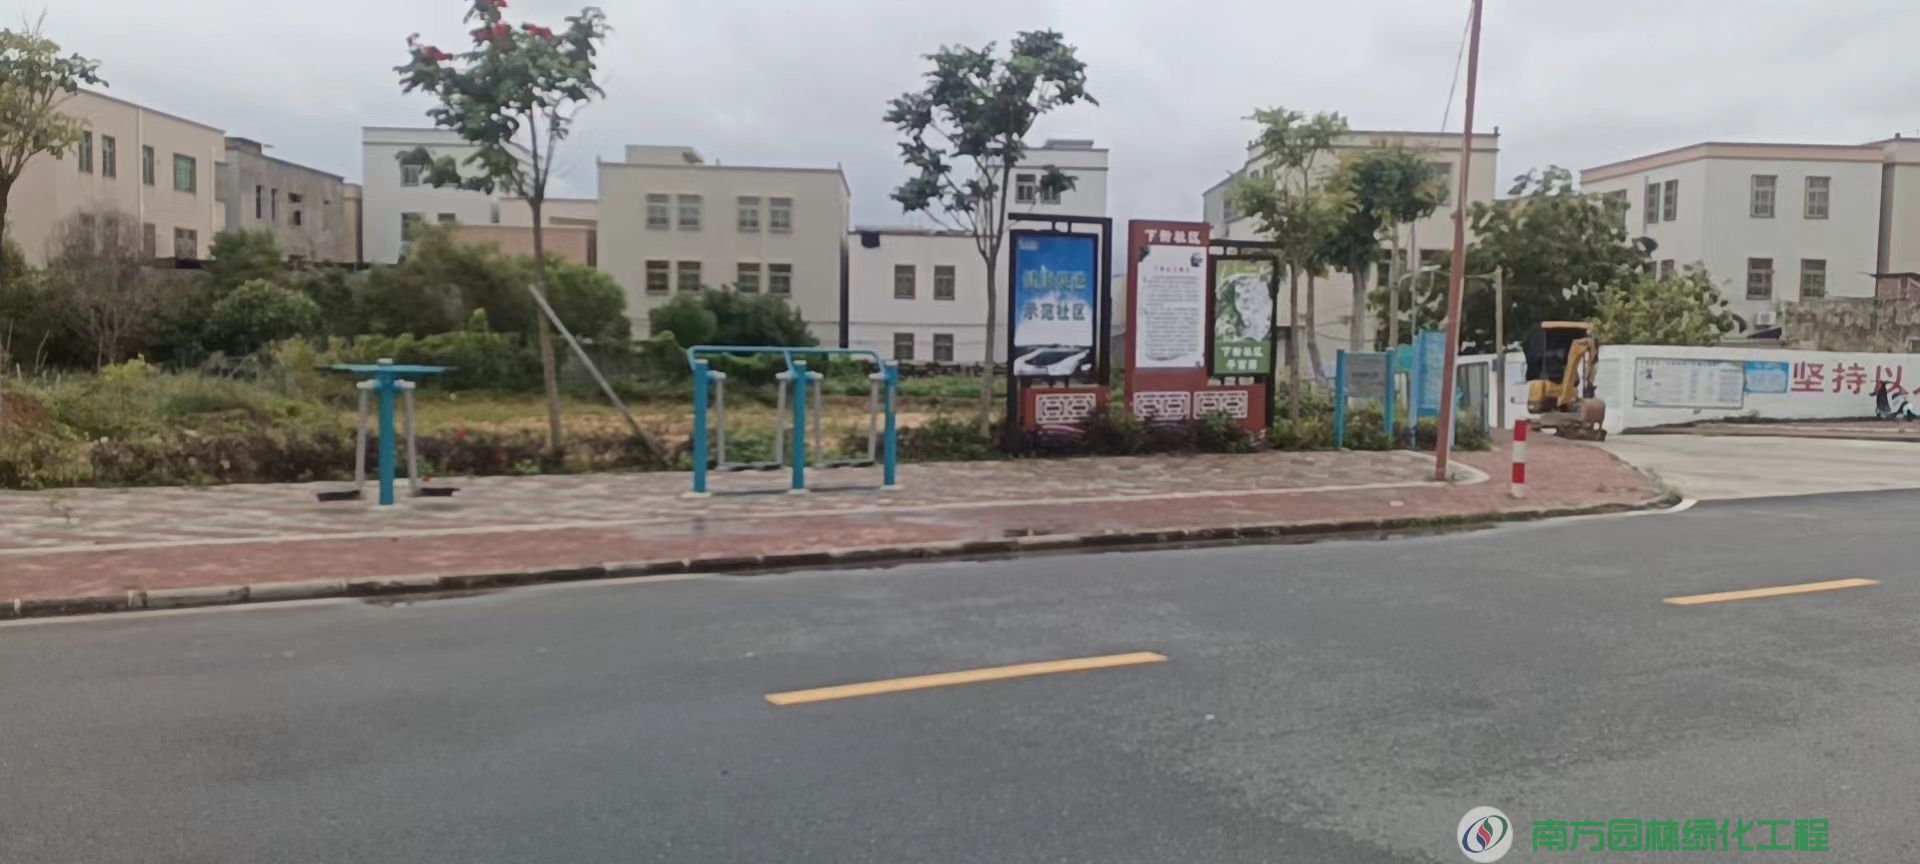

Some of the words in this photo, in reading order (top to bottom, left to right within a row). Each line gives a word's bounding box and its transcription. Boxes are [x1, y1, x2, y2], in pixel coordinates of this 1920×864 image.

[1024, 301, 1086, 321] 示范社区
[1791, 361, 1920, 395] 坚持以
